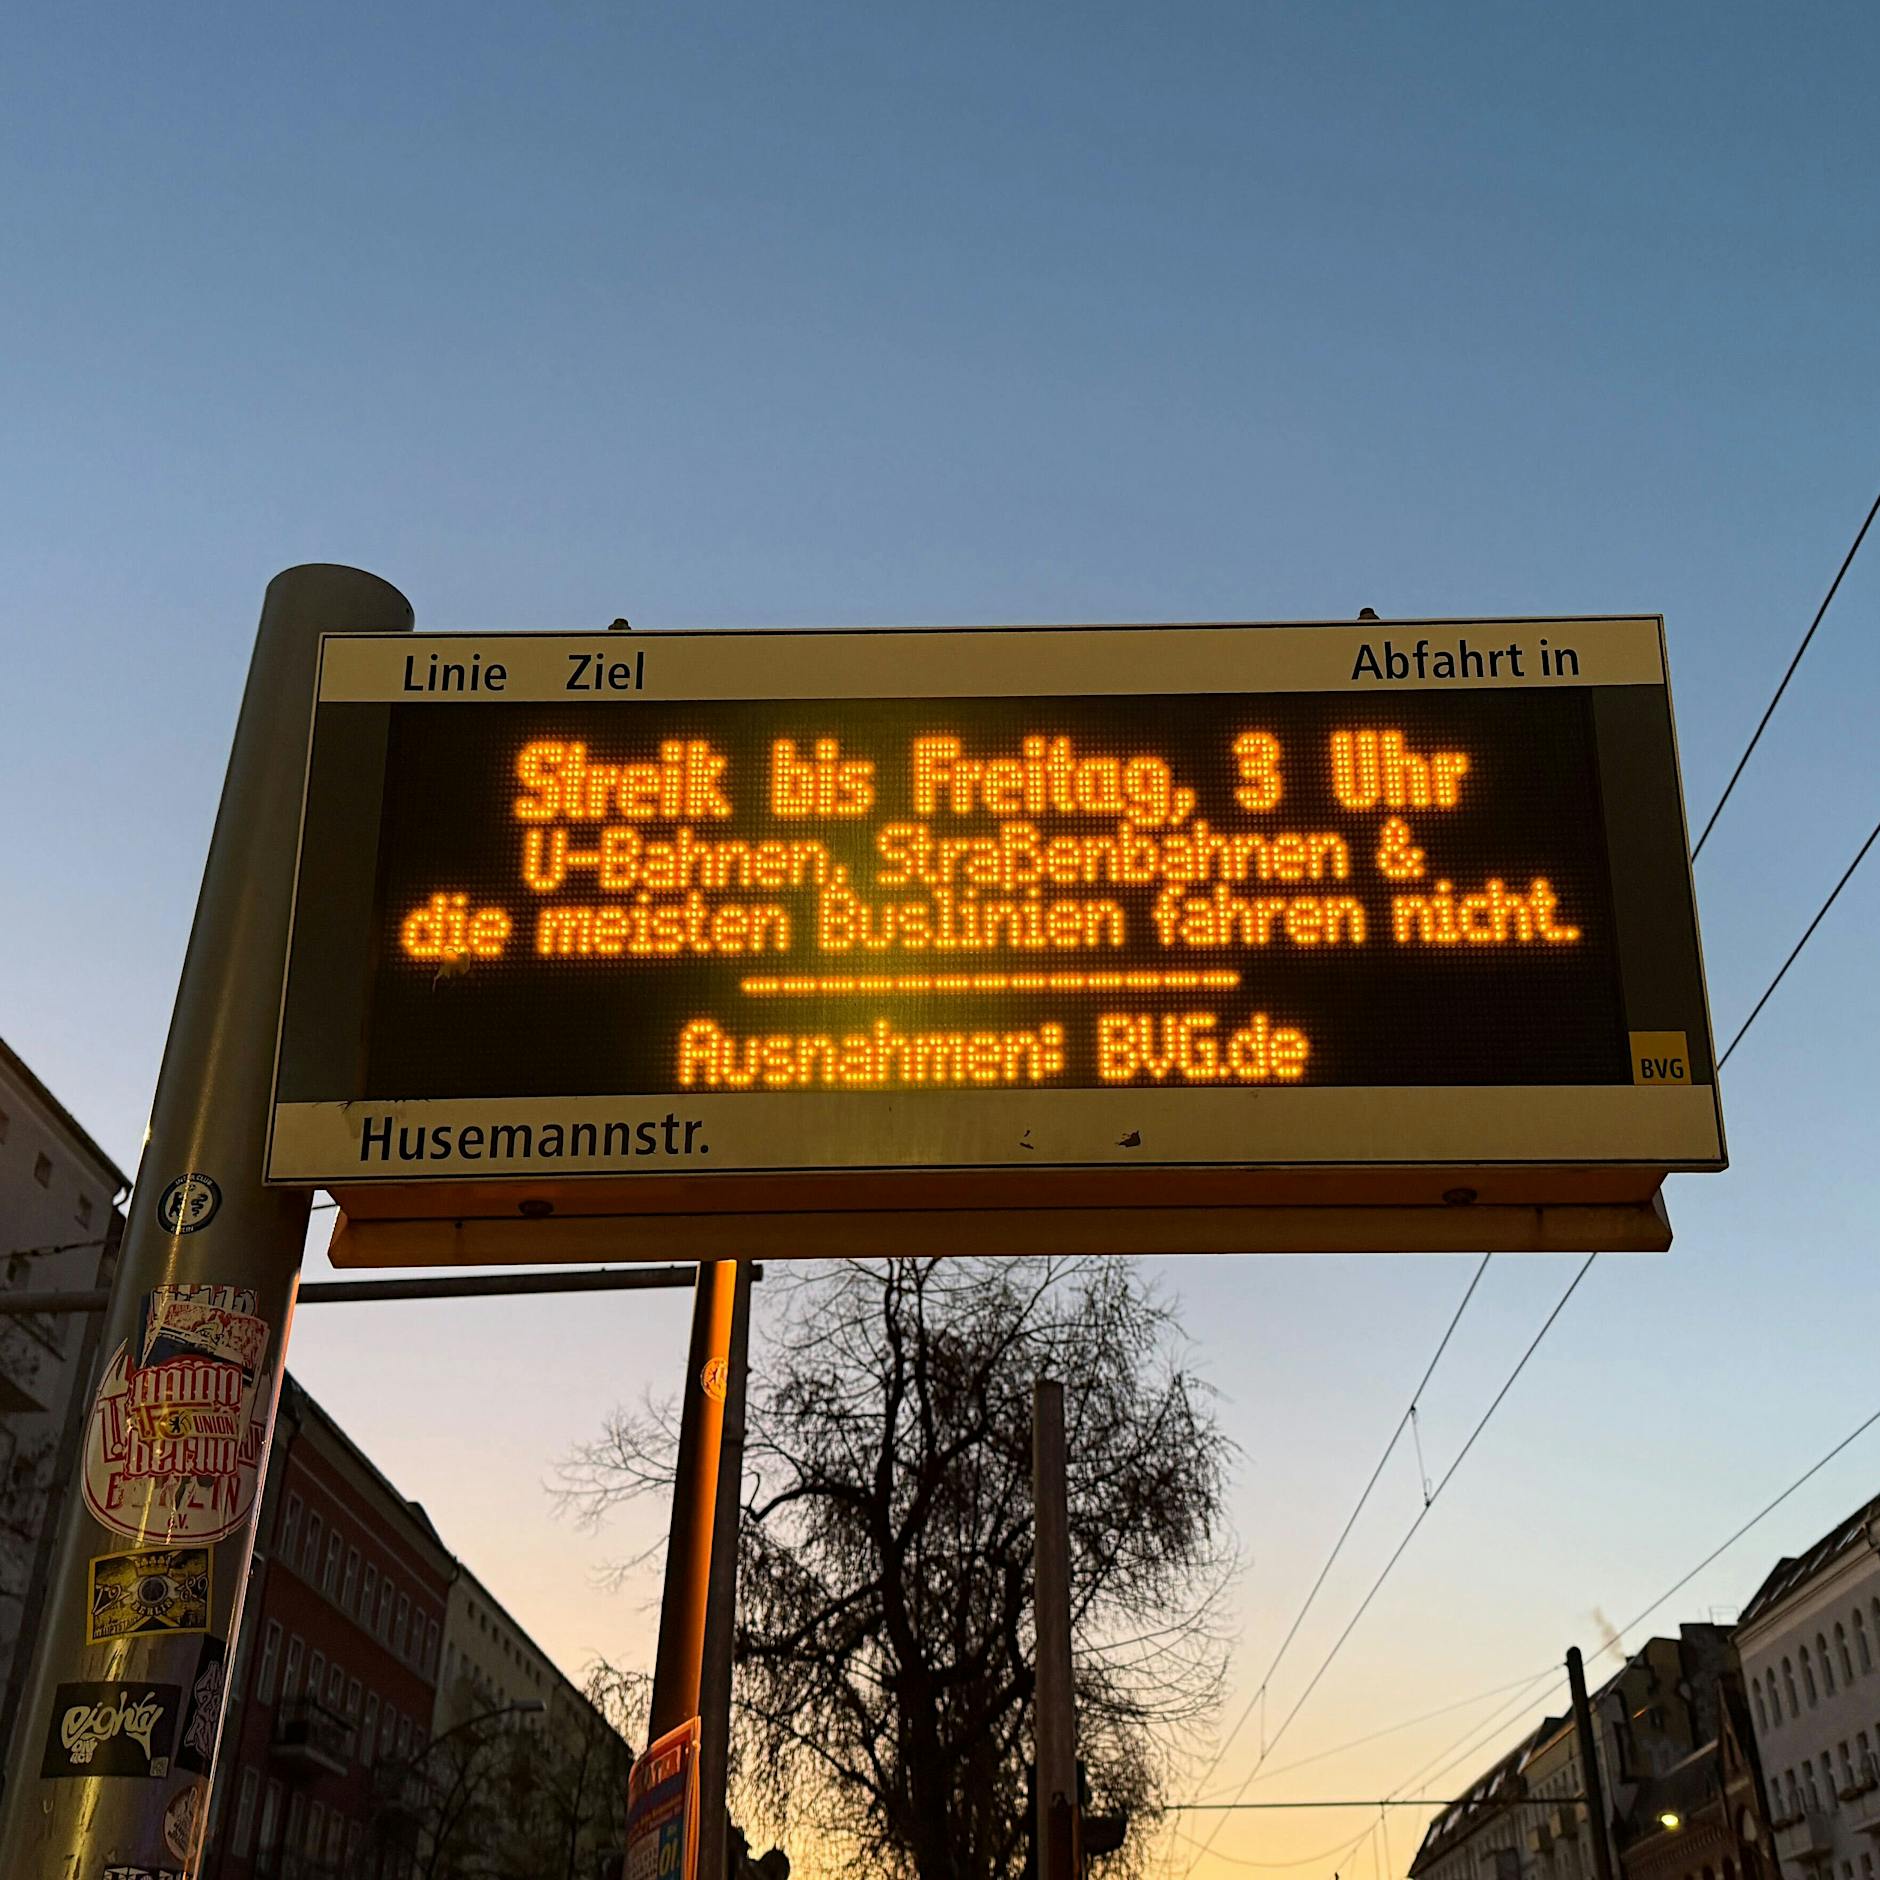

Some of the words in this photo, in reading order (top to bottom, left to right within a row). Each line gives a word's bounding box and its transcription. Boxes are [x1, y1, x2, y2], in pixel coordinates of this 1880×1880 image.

[403, 653, 507, 692] Linie
[566, 651, 645, 691] Ziel
[1351, 639, 1525, 681] Abfahrt
[1539, 638, 1580, 677] in
[516, 741, 731, 819] Streik
[771, 739, 874, 816] bis
[912, 736, 1197, 829] Freitag,
[1234, 732, 1281, 810] 3
[1331, 730, 1467, 808] Uhr
[524, 826, 846, 891] U-Bahnen,
[876, 821, 1348, 888] Straßenbahnen
[1377, 817, 1424, 878] &
[403, 895, 510, 958] die
[538, 891, 789, 954] meisten
[818, 884, 1124, 951] Buslinien
[1153, 884, 1365, 945] fahren
[1391, 877, 1581, 942] nicht.
[679, 1019, 1063, 1085] Ausnahmen:
[1098, 1013, 1308, 1080] BVG.de
[1640, 1057, 1686, 1080] BVG
[359, 1112, 711, 1163] Husemannstr.
